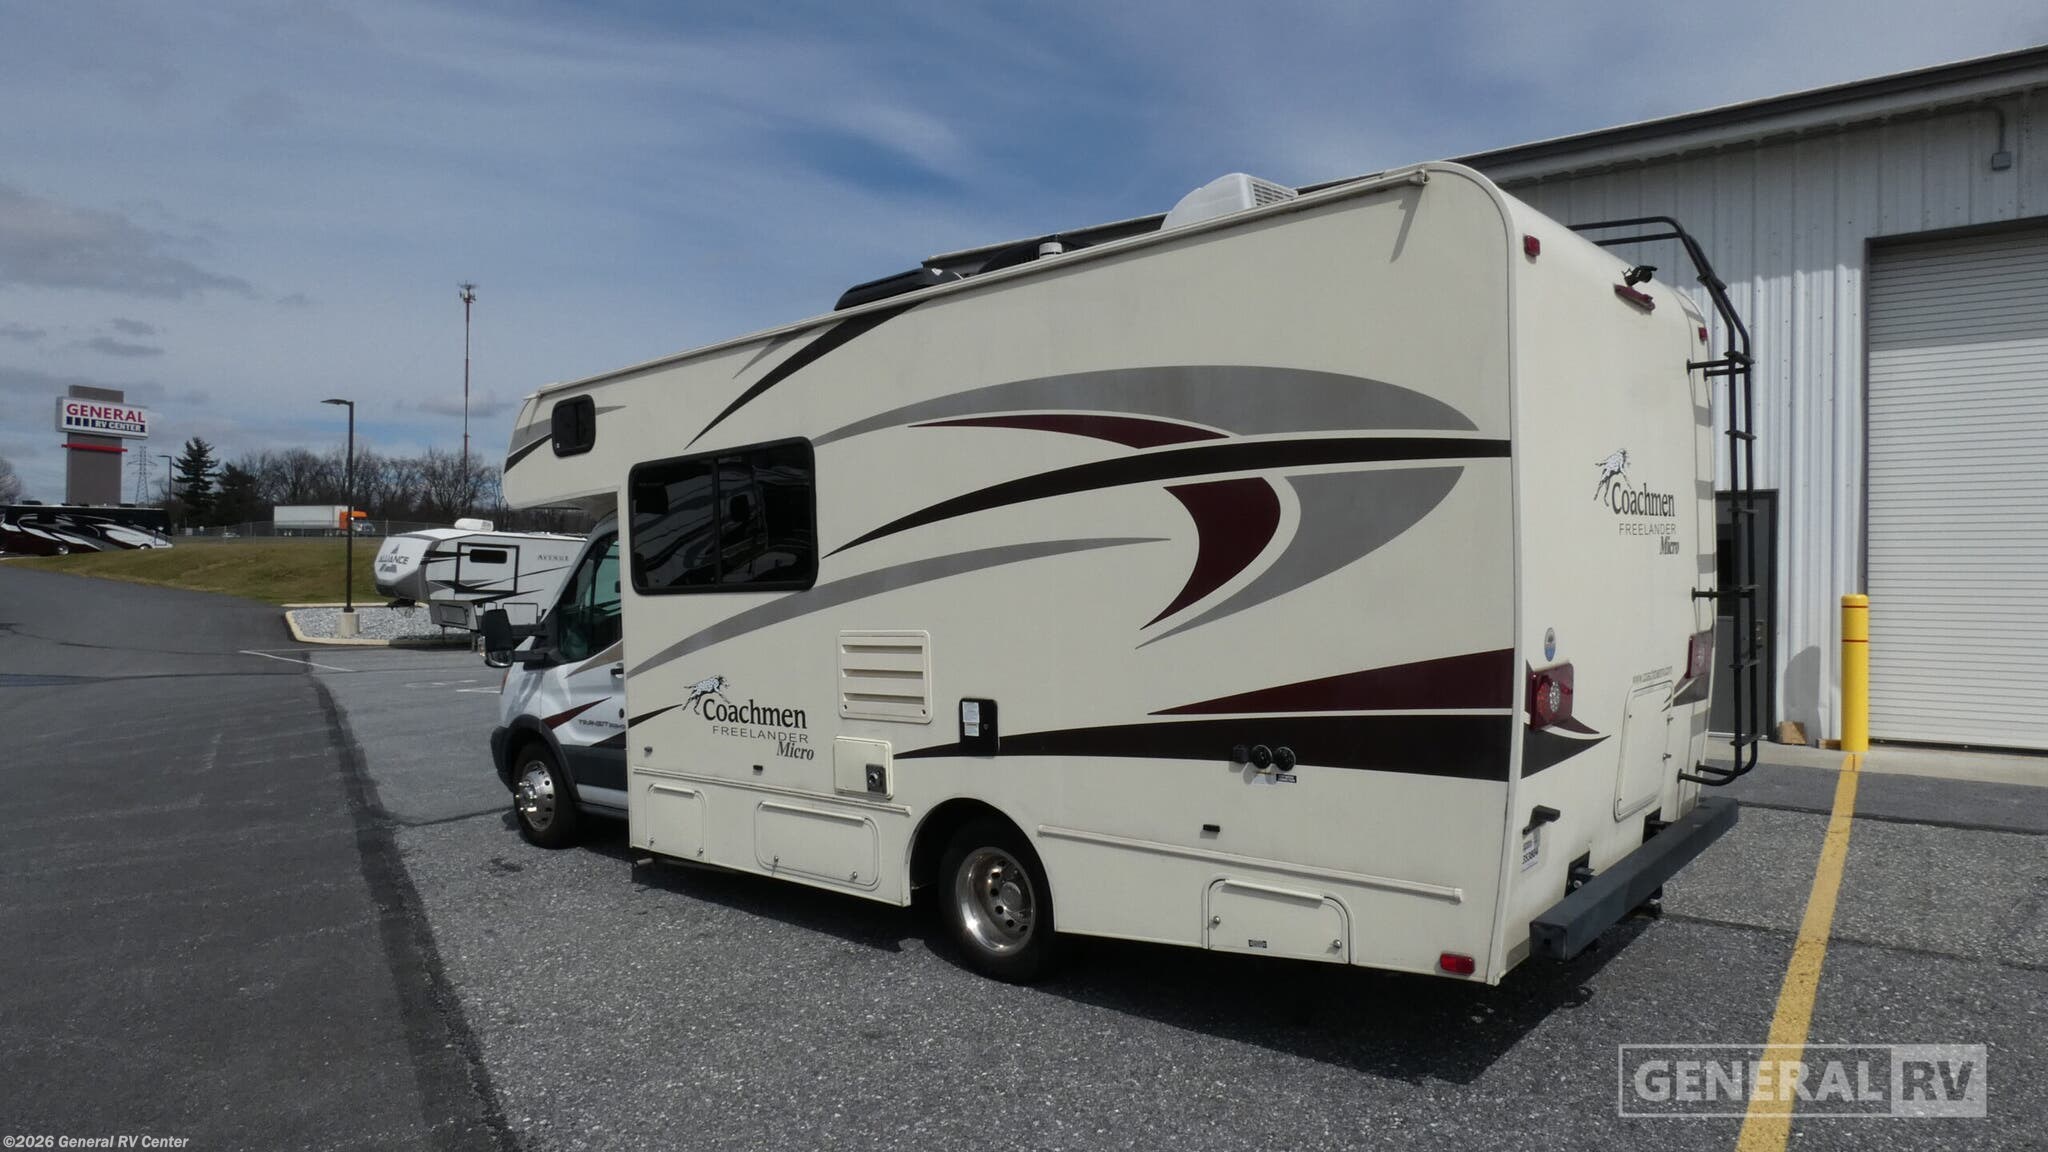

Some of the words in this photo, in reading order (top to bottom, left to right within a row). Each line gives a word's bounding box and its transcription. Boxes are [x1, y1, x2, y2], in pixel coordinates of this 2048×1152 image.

[66, 403, 146, 424] GENERAL
[95, 420, 107, 429] RV
[108, 421, 141, 432] CENTER
[1611, 482, 1676, 517] Coachmen
[1619, 522, 1677, 536] FREELANDER
[1659, 536, 1680, 555] Micro
[702, 699, 808, 729] Coachmen
[712, 725, 809, 744] FREELANDER
[776, 741, 815, 761] Micro
